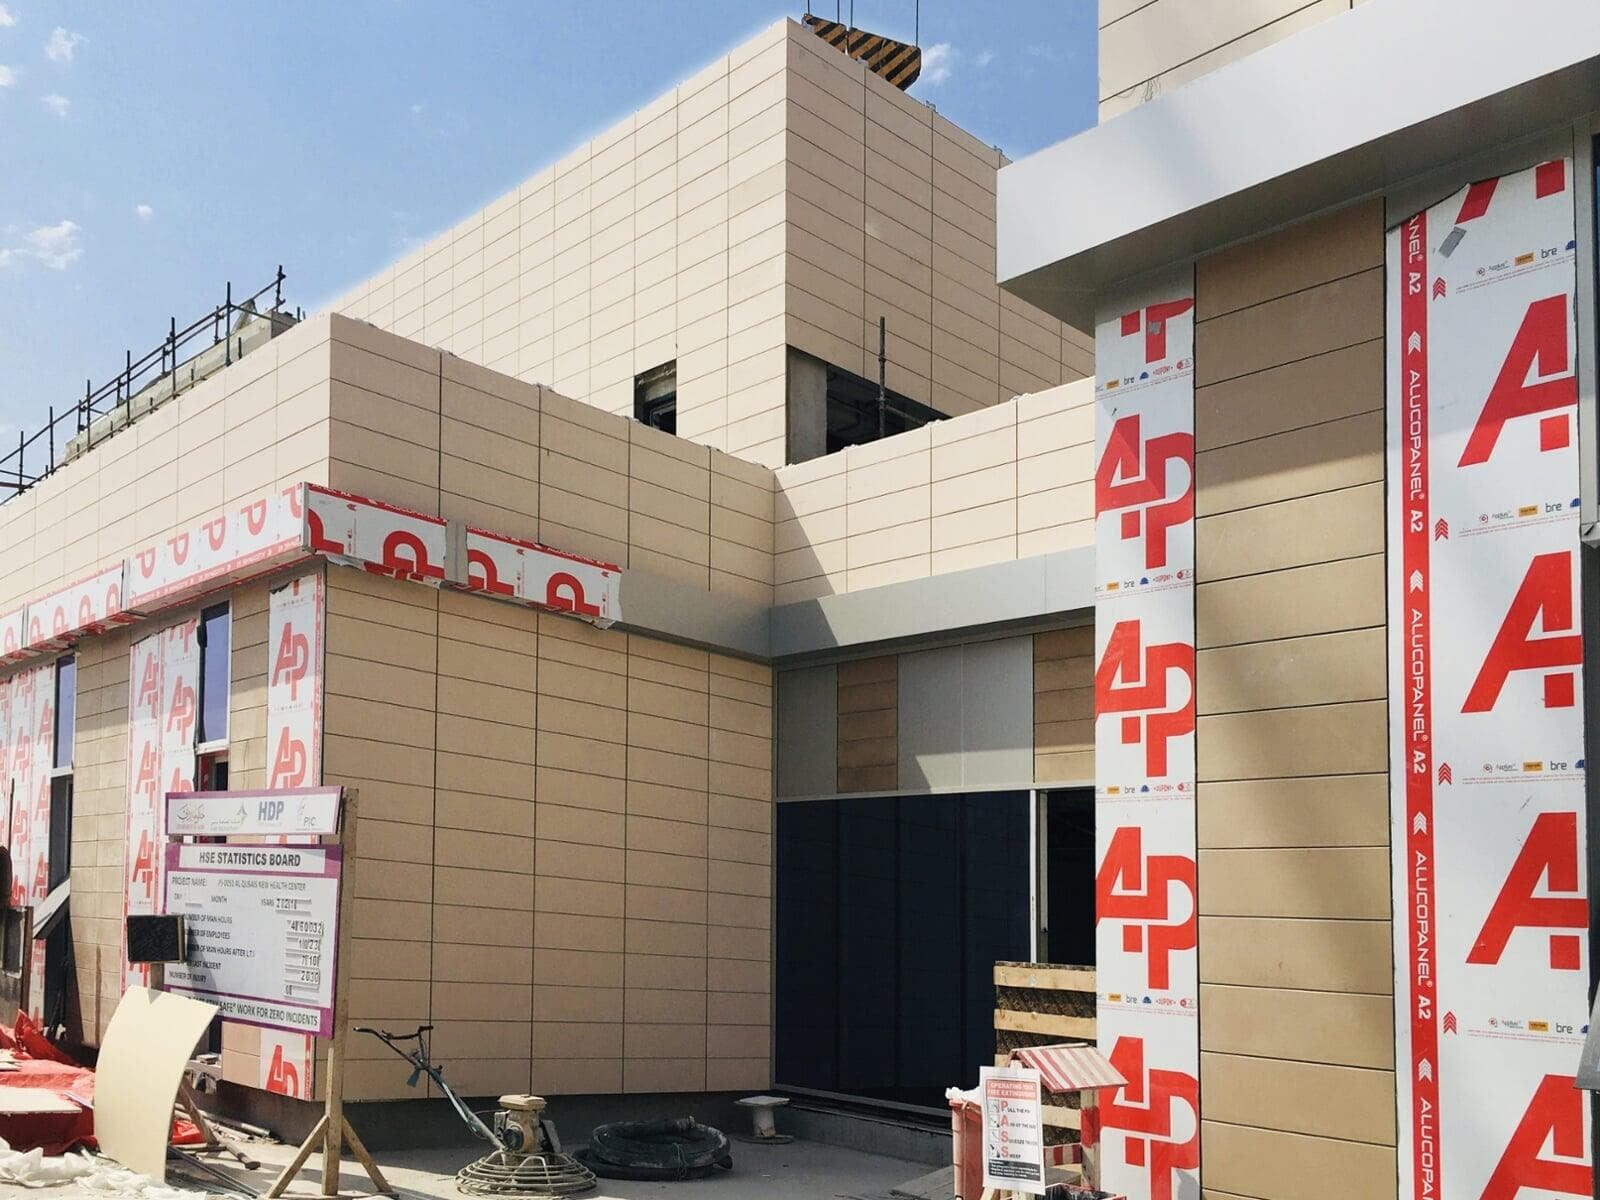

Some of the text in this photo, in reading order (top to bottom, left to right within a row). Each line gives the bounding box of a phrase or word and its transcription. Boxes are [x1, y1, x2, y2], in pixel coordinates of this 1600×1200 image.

[1541, 247, 1557, 259] bre
[1408, 272, 1422, 296] A2
[1545, 503, 1562, 513] bre
[1410, 509, 1423, 533] A2
[1413, 751, 1426, 774] A2
[1550, 761, 1567, 771] bre
[258, 801, 284, 821] HDP
[304, 816, 316, 827] PIC
[199, 851, 301, 867] HSE STATISTICS BOARD
[237, 1003, 255, 1016] WORK
[256, 1007, 268, 1018] FOR
[269, 1008, 285, 1021] ZERO
[285, 1010, 318, 1027] INCIDENTS
[1418, 994, 1431, 1019] A2
[1556, 1022, 1573, 1034] bre
